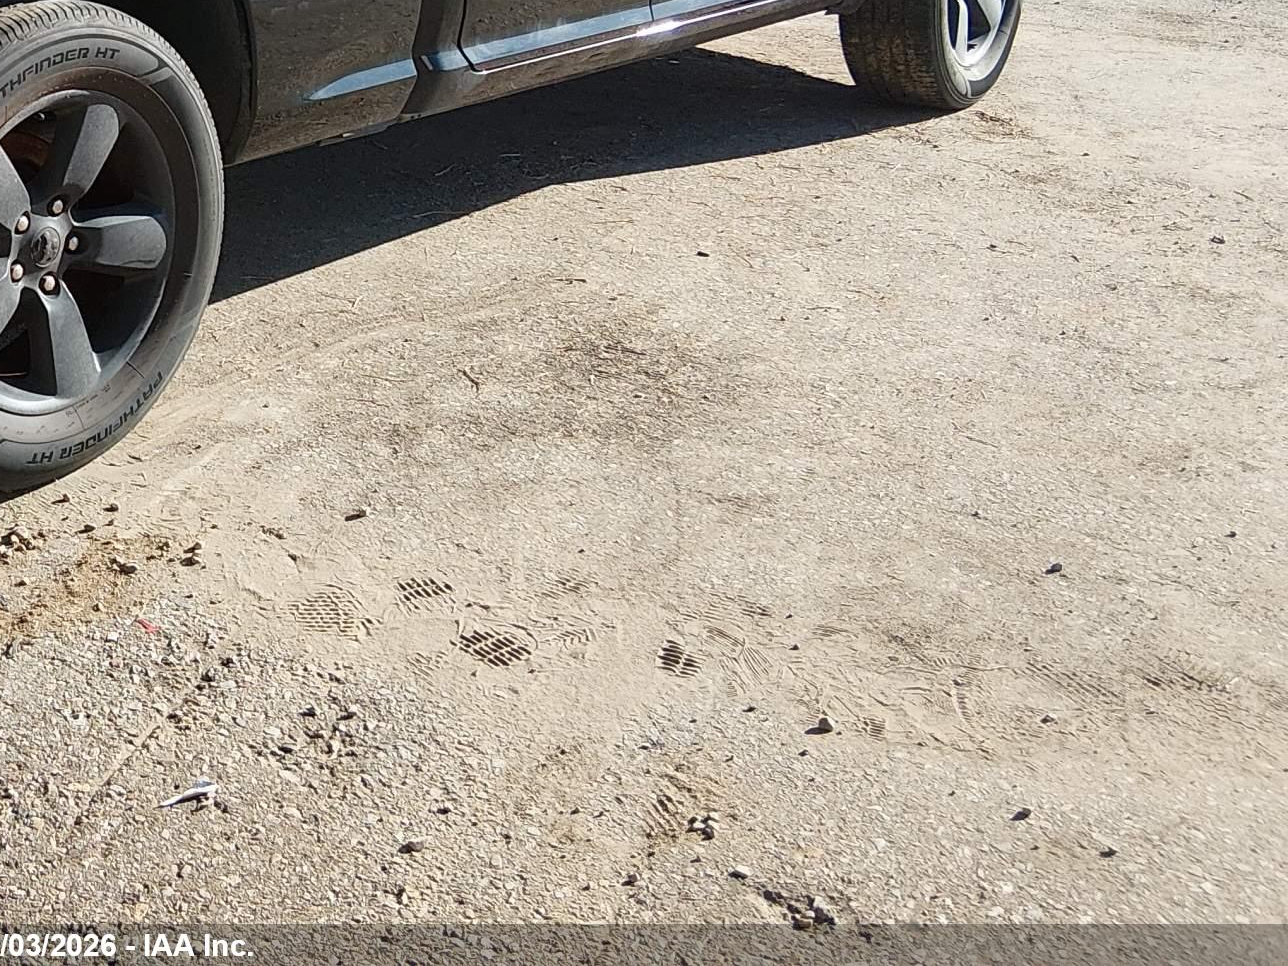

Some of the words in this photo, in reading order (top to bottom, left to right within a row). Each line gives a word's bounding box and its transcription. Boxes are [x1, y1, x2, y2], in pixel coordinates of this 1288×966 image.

[95, 46, 121, 60] HT
[59, 370, 163, 460] PATHFINDER
[26, 449, 54, 466] HT
